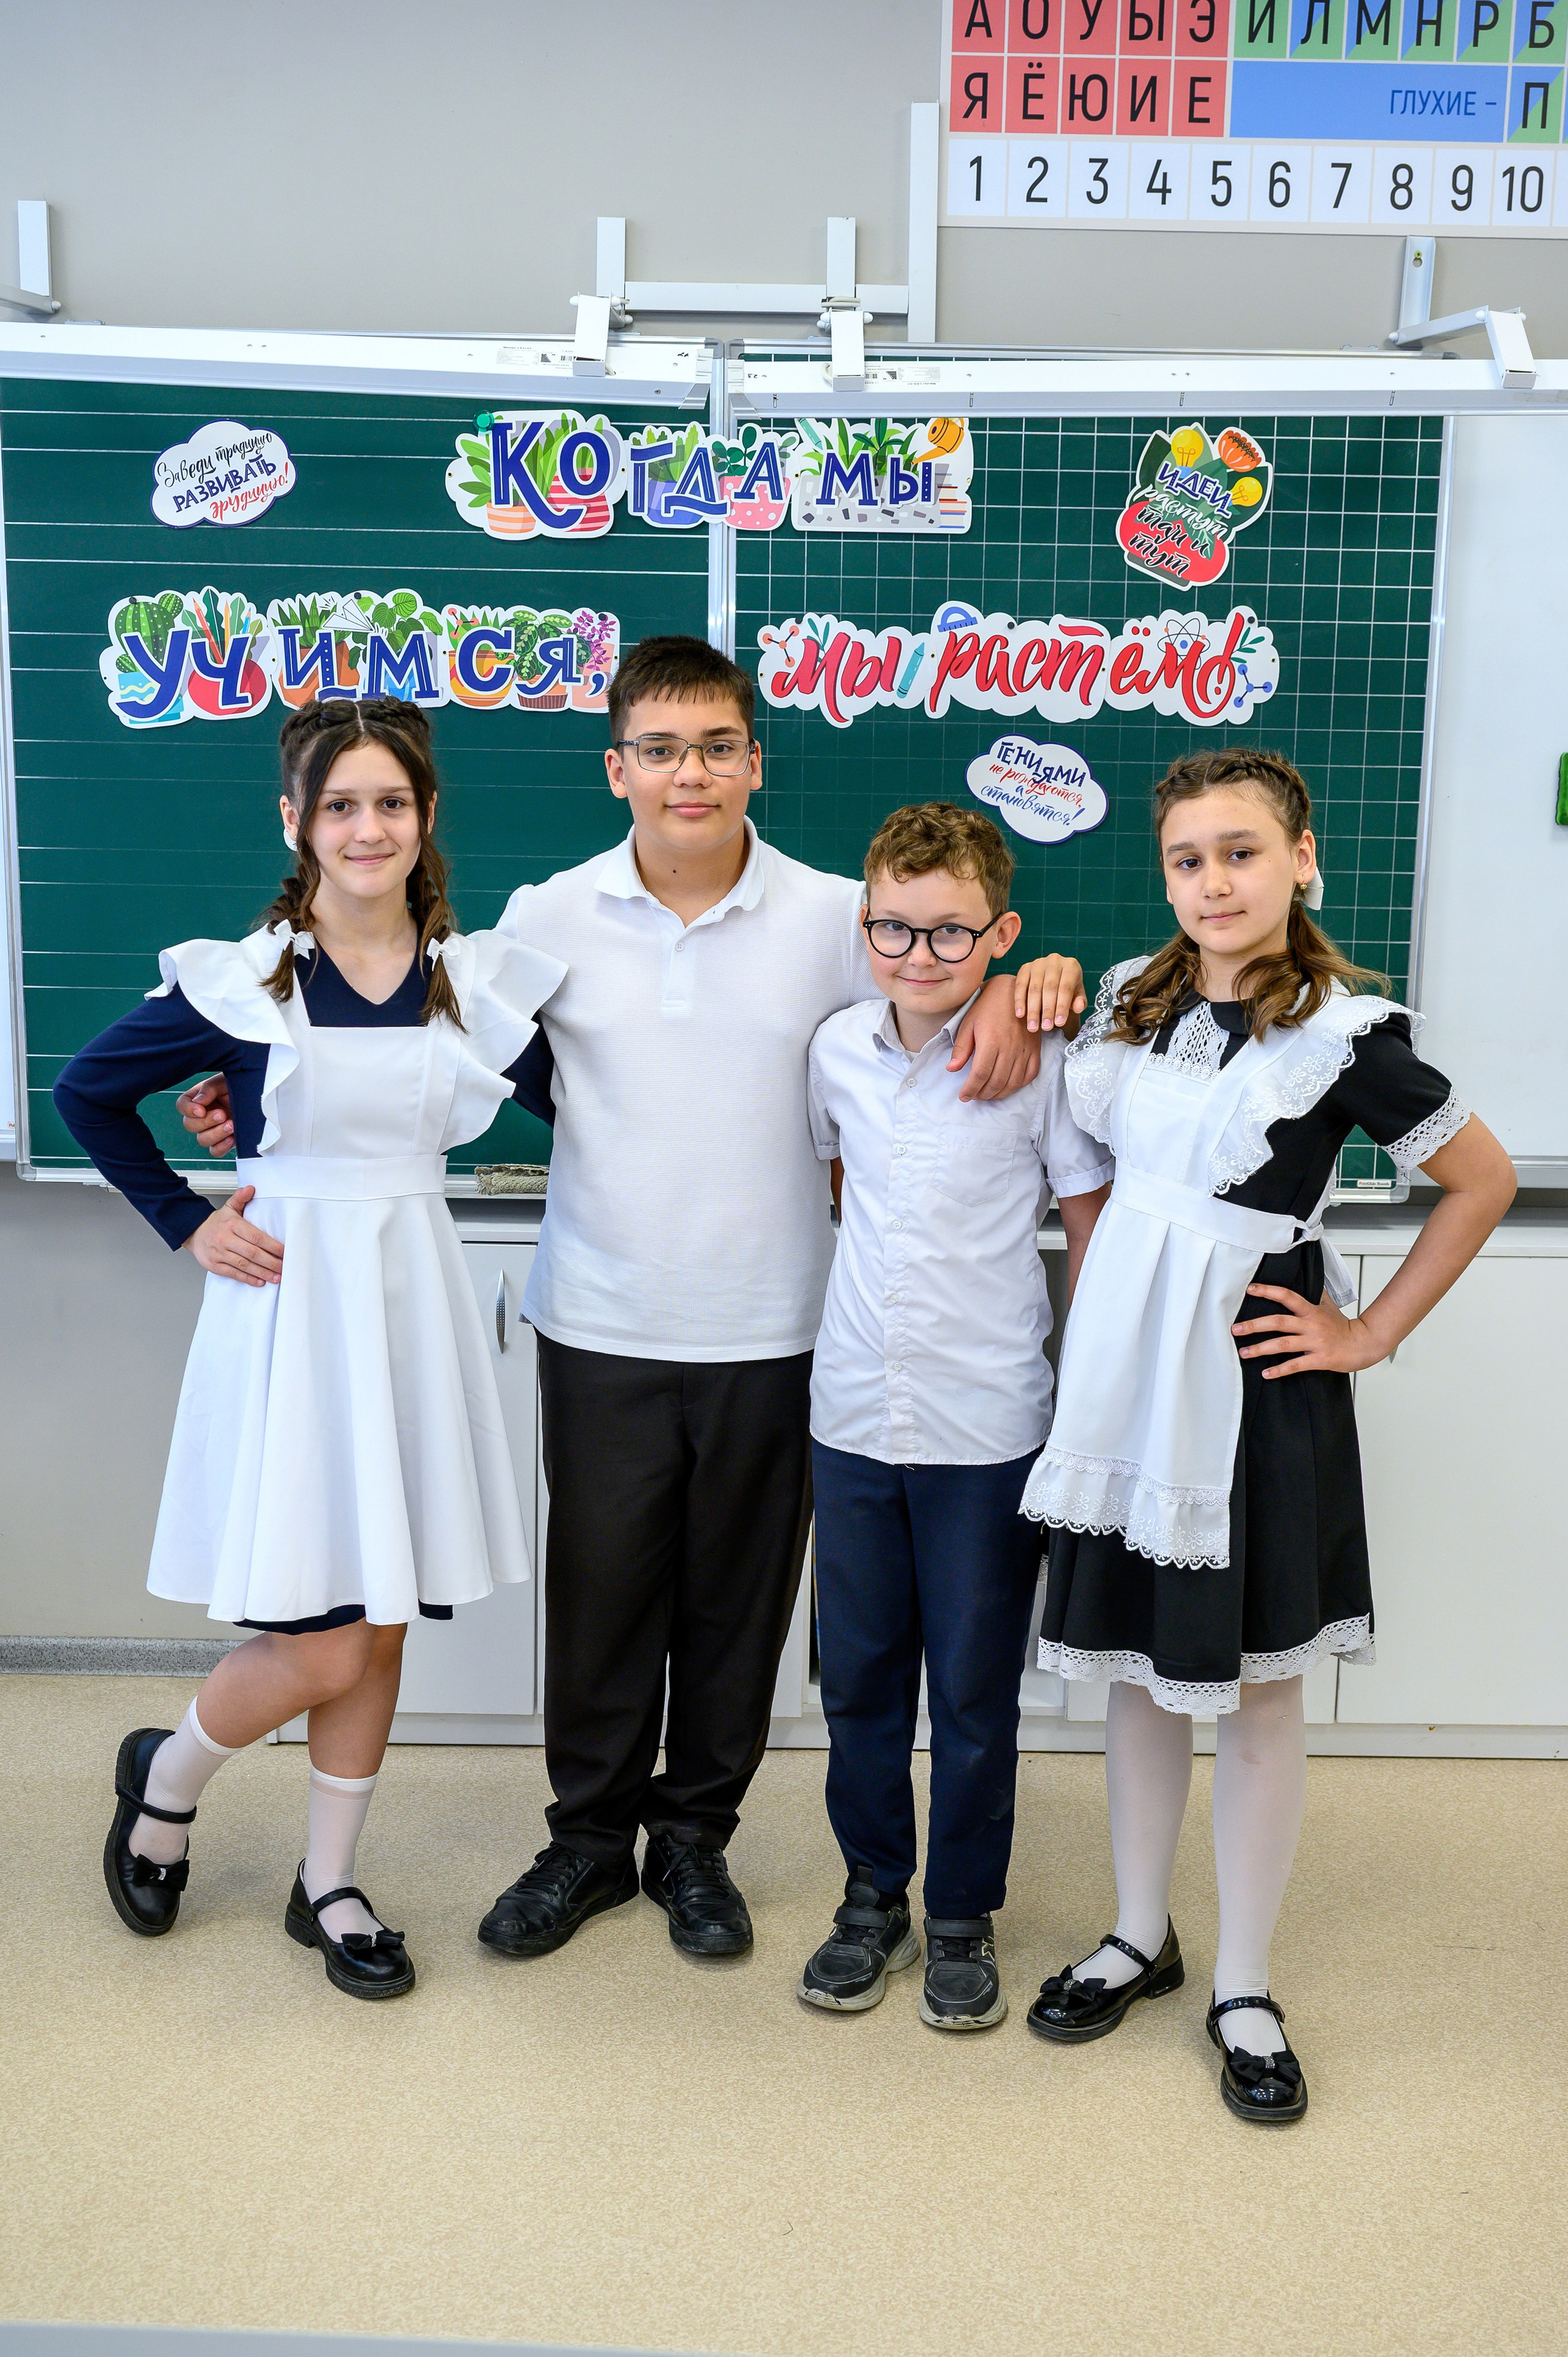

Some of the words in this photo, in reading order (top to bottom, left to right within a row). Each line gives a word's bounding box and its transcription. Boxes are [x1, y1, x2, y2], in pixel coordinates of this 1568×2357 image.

[964, 0, 993, 38] А
[1079, 0, 1103, 40] У
[1128, 0, 1164, 42] Ы
[1188, 0, 1216, 43] Э
[1300, 0, 1330, 45] Л
[1355, 0, 1391, 45] М
[1415, 0, 1442, 47] Н
[1472, 0, 1499, 47] Р
[1528, 1, 1555, 48] Б
[962, 72, 989, 119] Я
[1022, 61, 1046, 120] Ё
[1068, 74, 1108, 121] Ю
[1130, 75, 1158, 123] И
[1188, 77, 1212, 124] Е
[1389, 89, 1477, 116] ГЛУХИЕ
[1522, 82, 1549, 129] П
[969, 156, 982, 202] 1
[1025, 156, 1049, 203] 2
[1086, 157, 1109, 204] 3
[1146, 159, 1172, 205] 4
[1210, 160, 1232, 206] 5
[1268, 161, 1291, 208] 6
[1330, 162, 1352, 208] 7
[1390, 164, 1413, 210] 8
[1451, 164, 1473, 211] 9
[1502, 165, 1544, 213] 10
[157, 456, 216, 488] Заведи
[215, 432, 272, 467] традицию
[172, 454, 276, 513] РАЗВИВАТЬ
[209, 461, 288, 521] эрудицию!
[1133, 484, 1228, 539] растут
[1158, 462, 1231, 516] ИДЕИ
[1129, 532, 1190, 577] тут
[1190, 538, 1207, 557] и
[771, 631, 902, 723] мы
[989, 764, 1003, 774] не
[997, 741, 1086, 787] ГЕНИЯМИ
[980, 785, 1085, 826] становятся!
[1015, 785, 1023, 796] а
